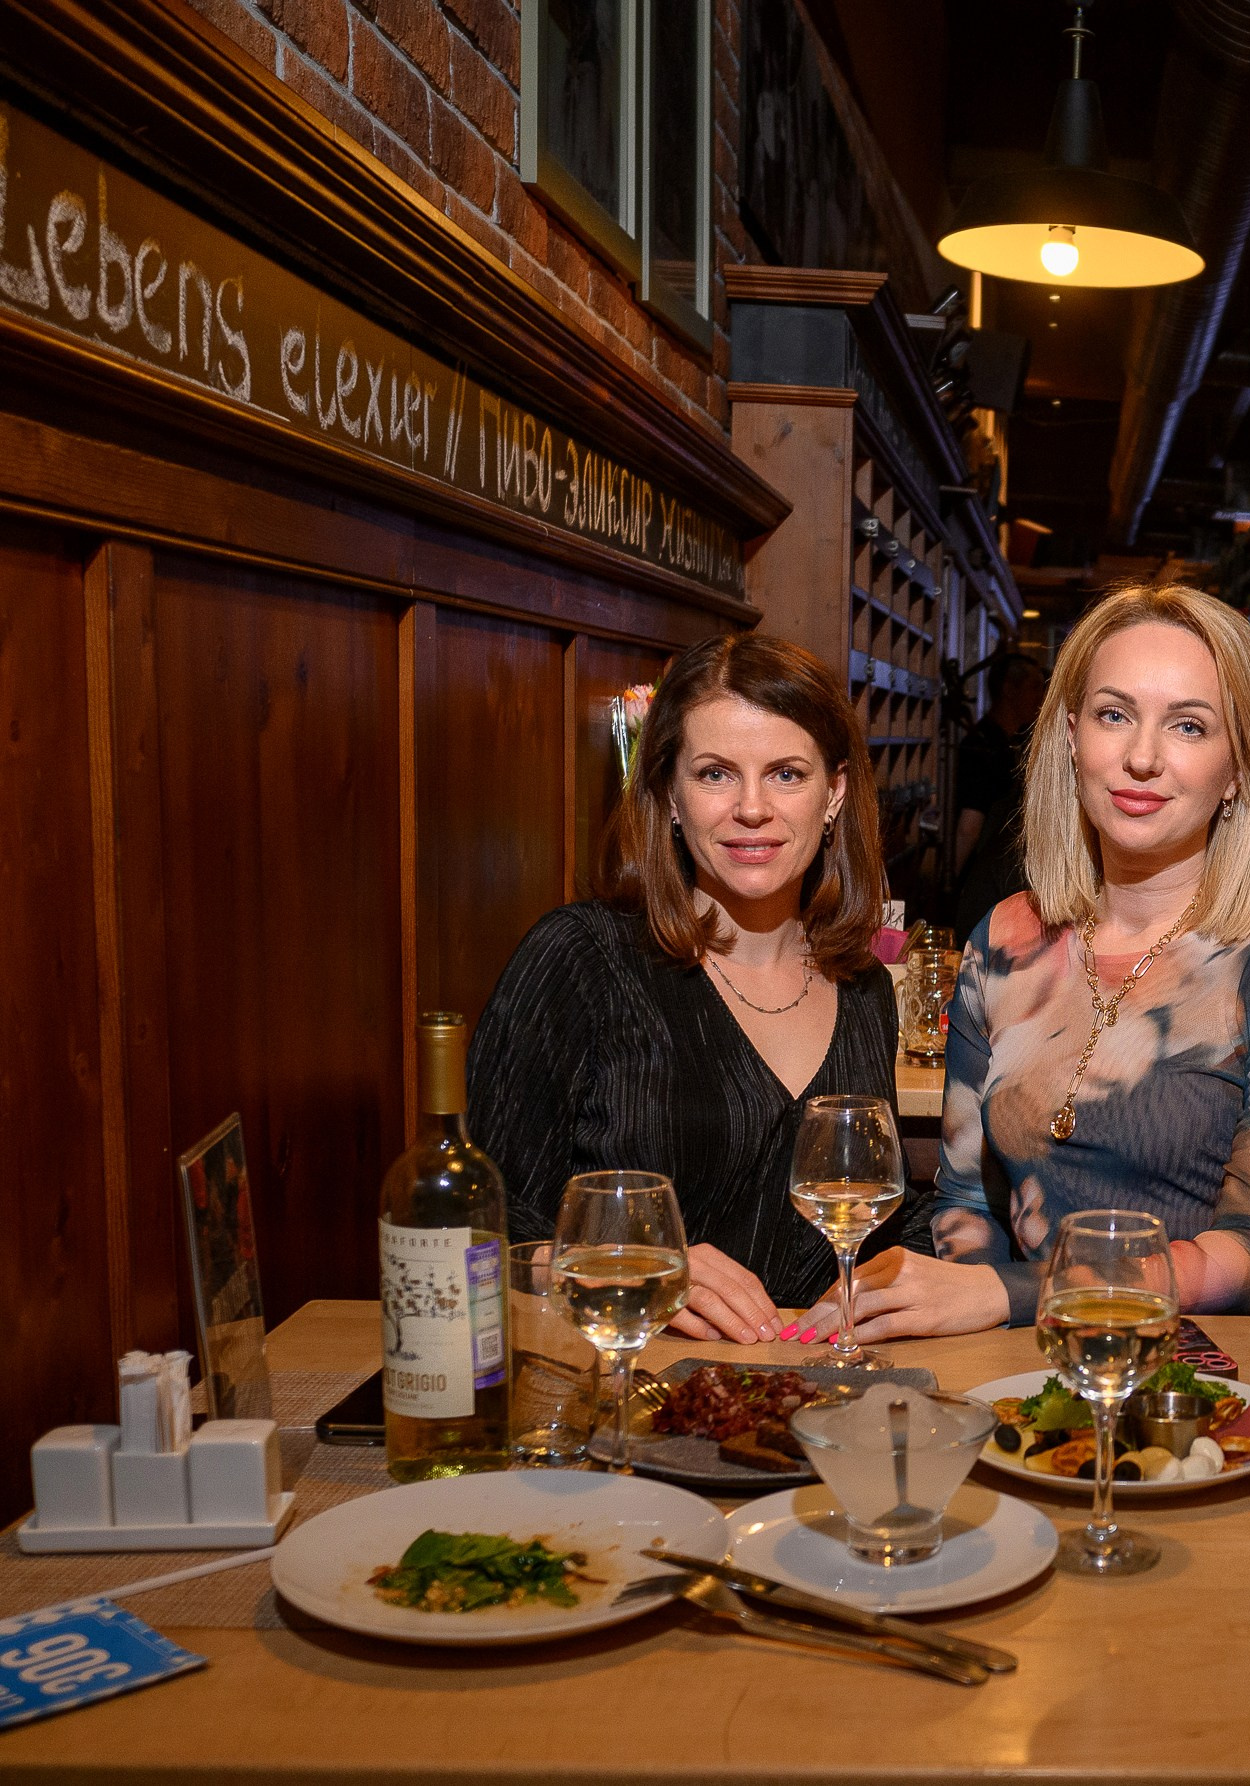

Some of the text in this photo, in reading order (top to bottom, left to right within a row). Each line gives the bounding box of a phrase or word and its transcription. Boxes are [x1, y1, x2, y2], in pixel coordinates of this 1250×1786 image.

[0, 110, 251, 402] Lebens
[397, 1370, 447, 1393] GRIGIO
[0, 1632, 132, 1695] 306
